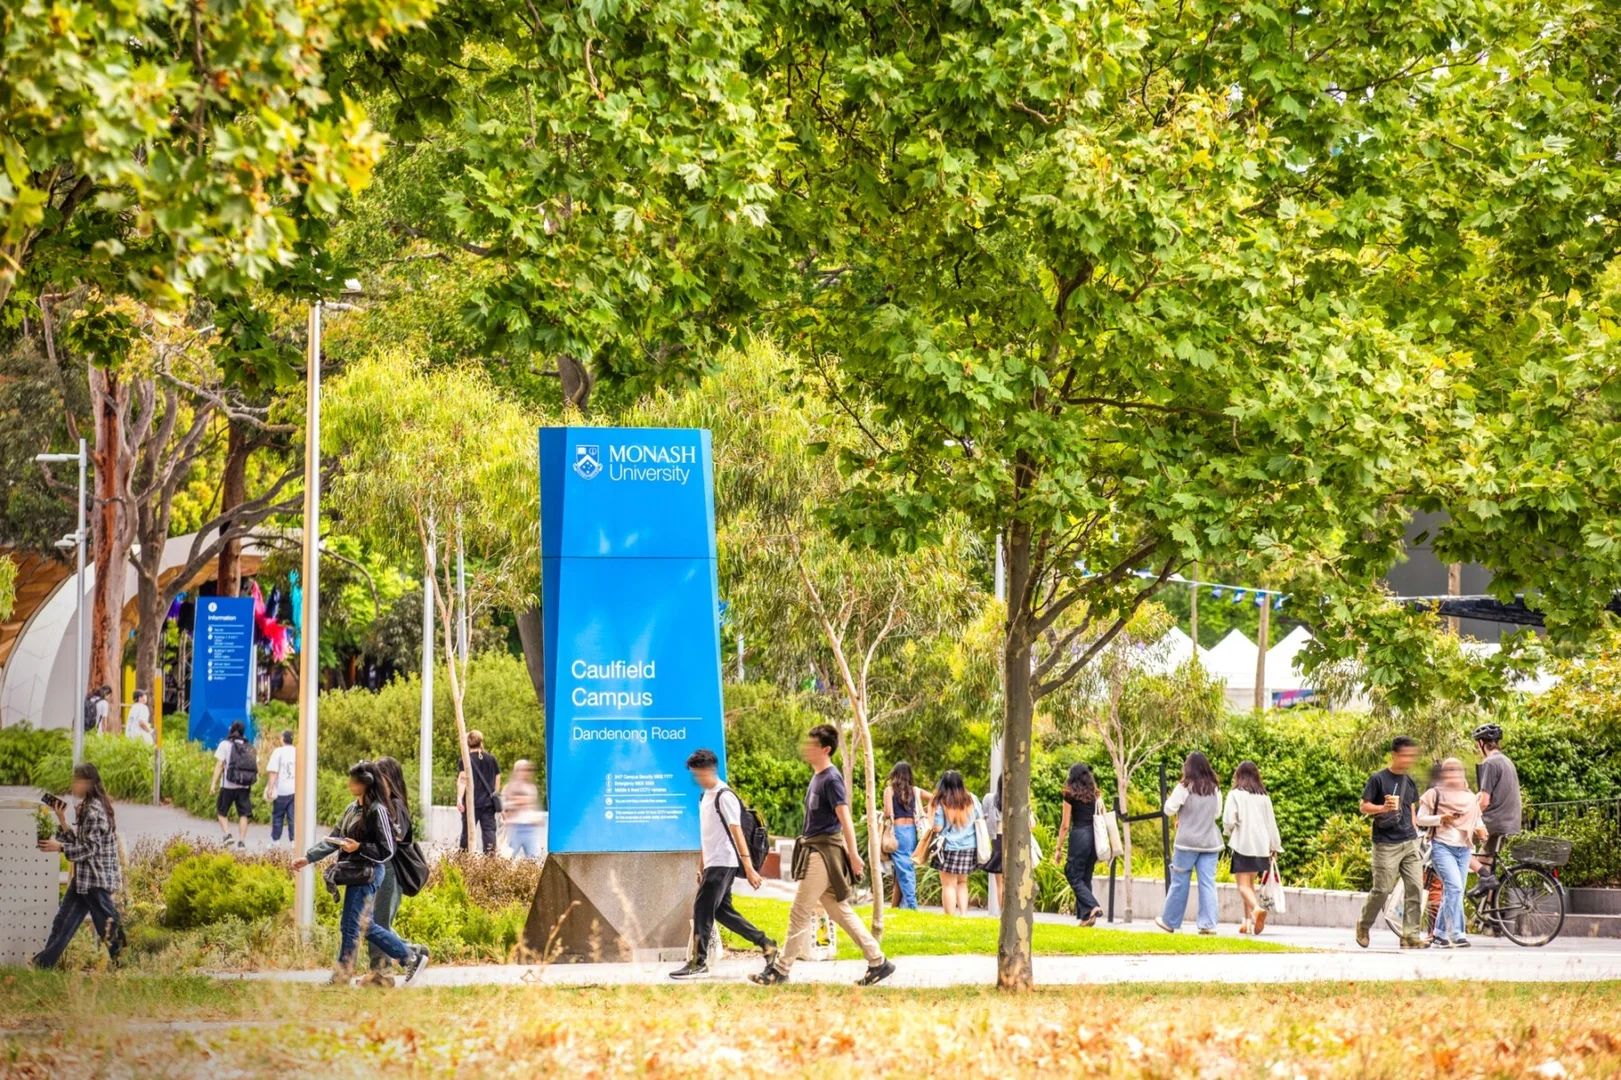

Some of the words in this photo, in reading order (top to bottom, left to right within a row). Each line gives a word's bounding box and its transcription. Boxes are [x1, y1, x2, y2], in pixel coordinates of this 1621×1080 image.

[609, 445, 696, 463] MONASH
[609, 463, 690, 485] University
[571, 659, 655, 679] Caulfield
[571, 687, 653, 710] Campus
[573, 727, 647, 743] Dandenong
[651, 726, 686, 740] Road
